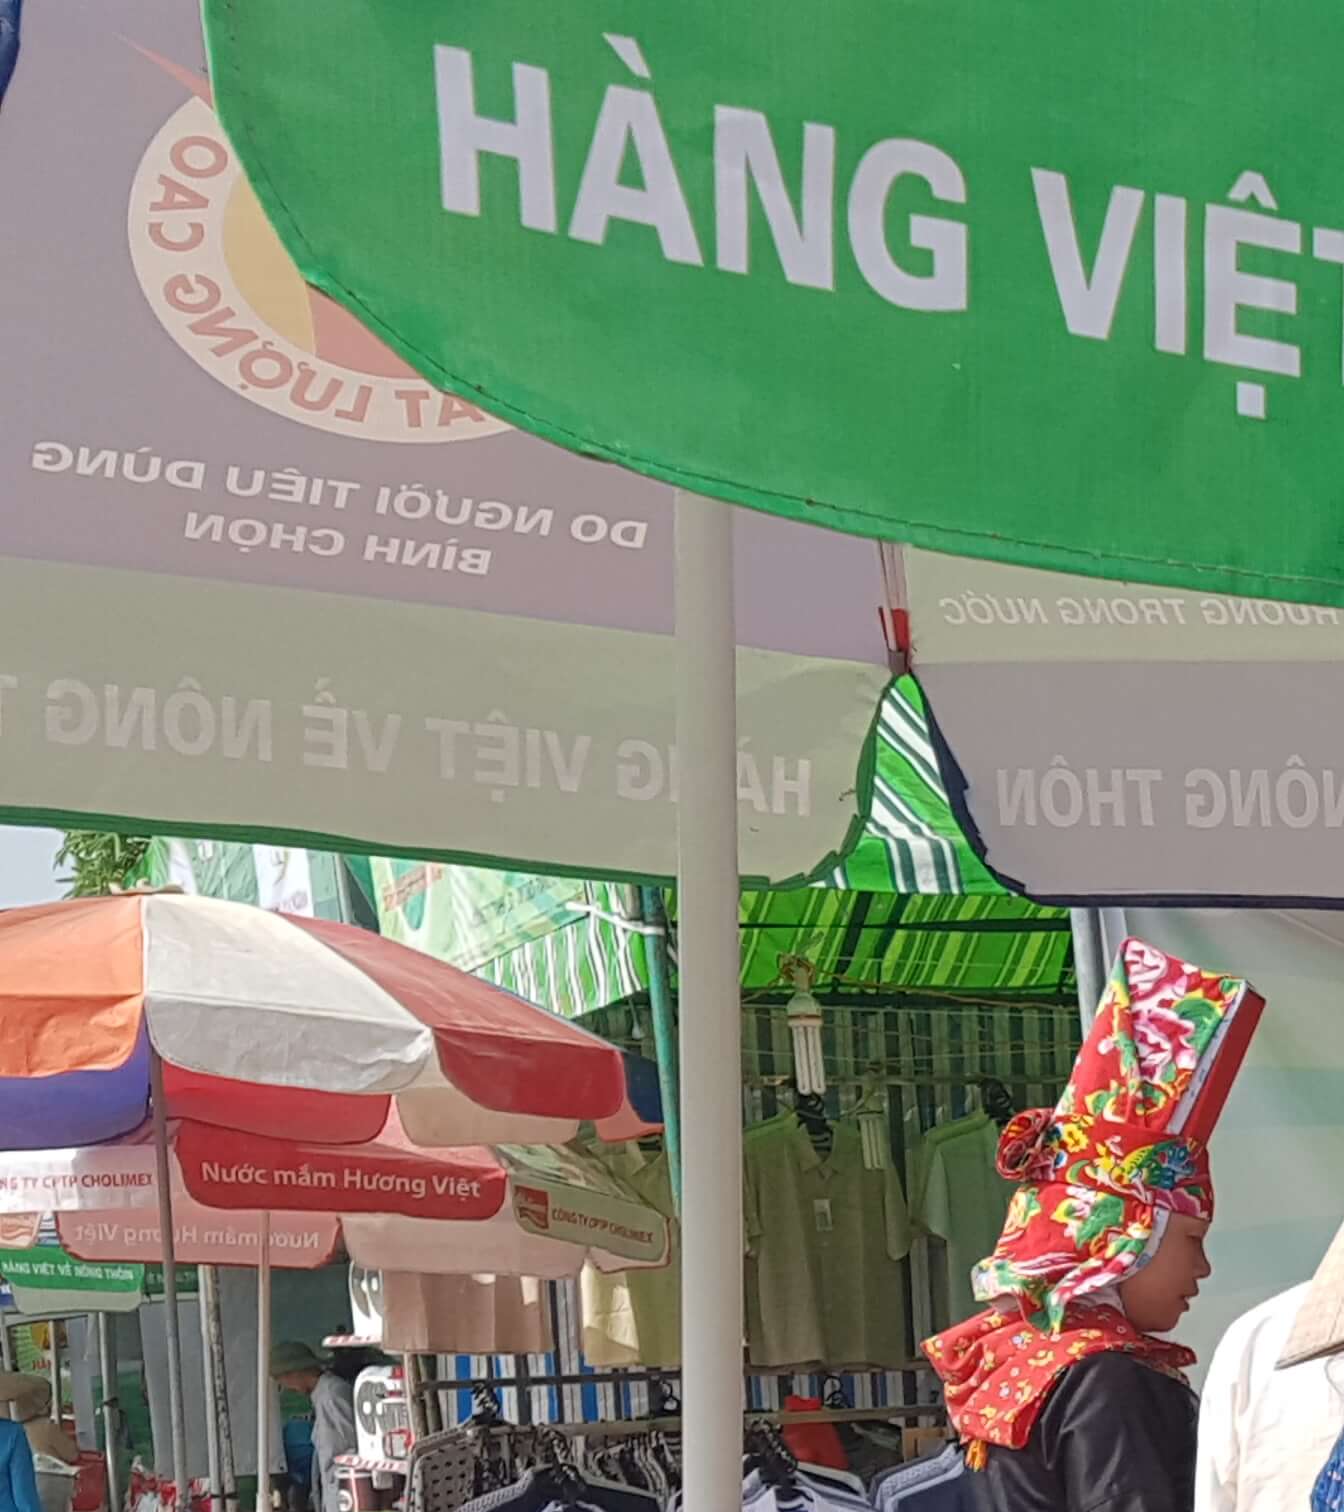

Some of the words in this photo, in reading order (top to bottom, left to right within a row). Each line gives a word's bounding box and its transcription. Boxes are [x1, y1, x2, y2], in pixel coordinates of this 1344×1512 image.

[434, 33, 967, 311] HÀNG
[202, 1162, 268, 1185] Nước
[273, 1166, 335, 1190] mắm
[343, 1167, 426, 1197] Hương
[432, 1176, 481, 1201] Việt
